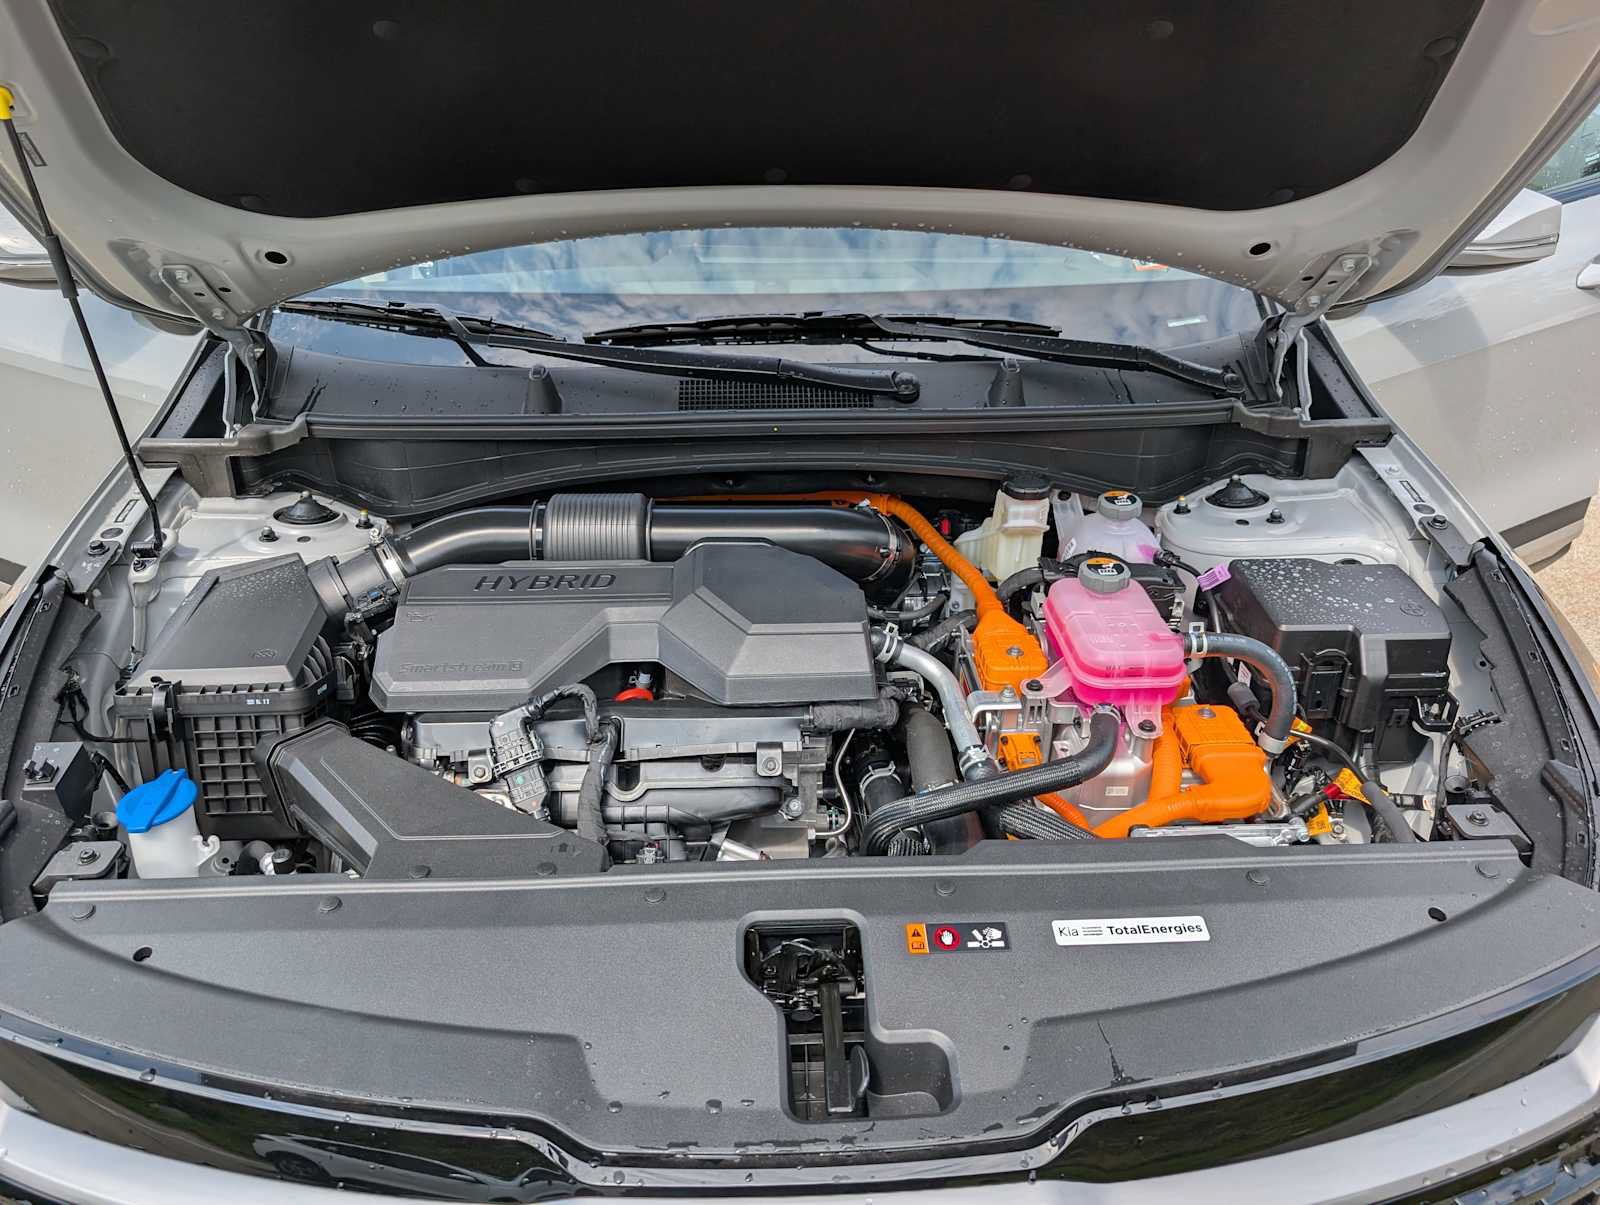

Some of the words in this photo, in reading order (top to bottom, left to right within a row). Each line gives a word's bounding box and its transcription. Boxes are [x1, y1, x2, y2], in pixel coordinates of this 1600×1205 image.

[473, 574, 617, 592] HYBRID
[1058, 927, 1079, 937] Kia
[1107, 923, 1203, 937] TotalEnergies
